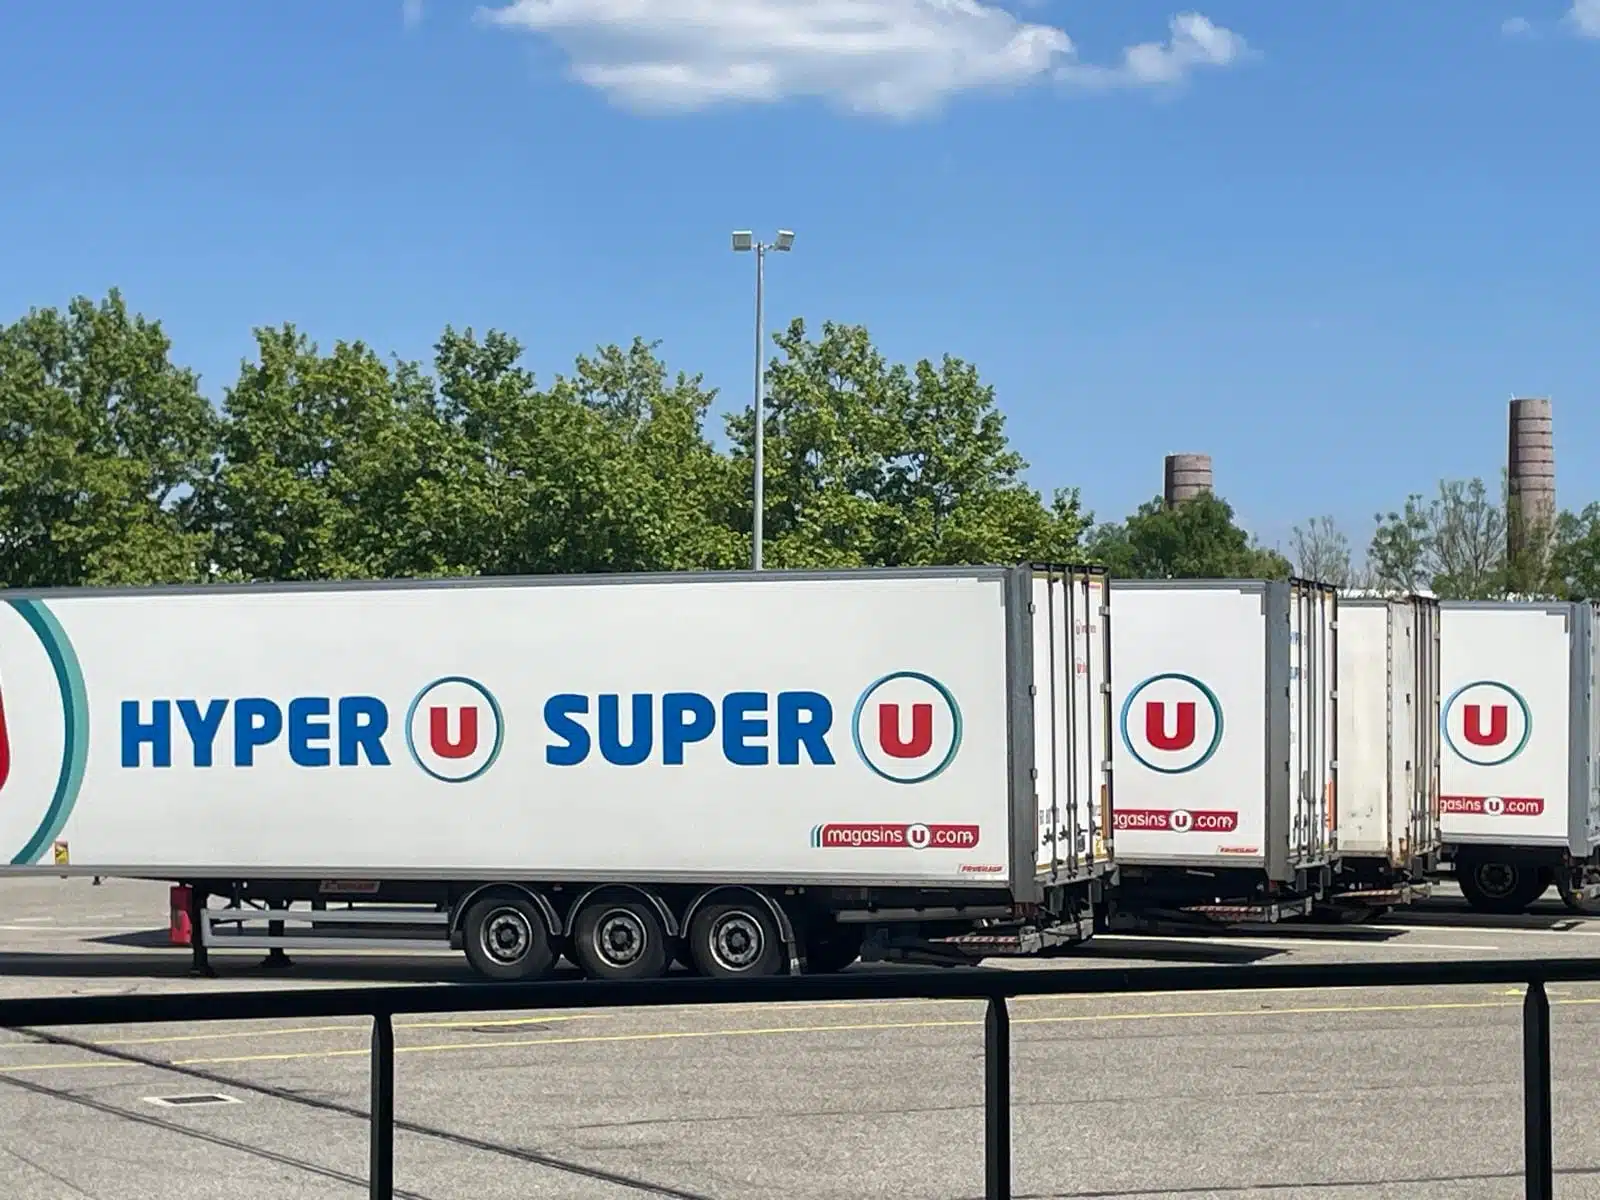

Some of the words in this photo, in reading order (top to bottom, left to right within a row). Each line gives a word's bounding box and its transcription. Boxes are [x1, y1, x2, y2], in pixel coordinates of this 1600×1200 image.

[120, 696, 391, 768] HYPER
[429, 707, 477, 758] U
[542, 690, 835, 766] SUPER
[879, 703, 933, 758] U
[1145, 701, 1195, 751] U
[1463, 704, 1507, 747] U
[1112, 811, 1167, 829] agasins
[1438, 798, 1481, 813] gasins
[827, 825, 904, 846] magasins
